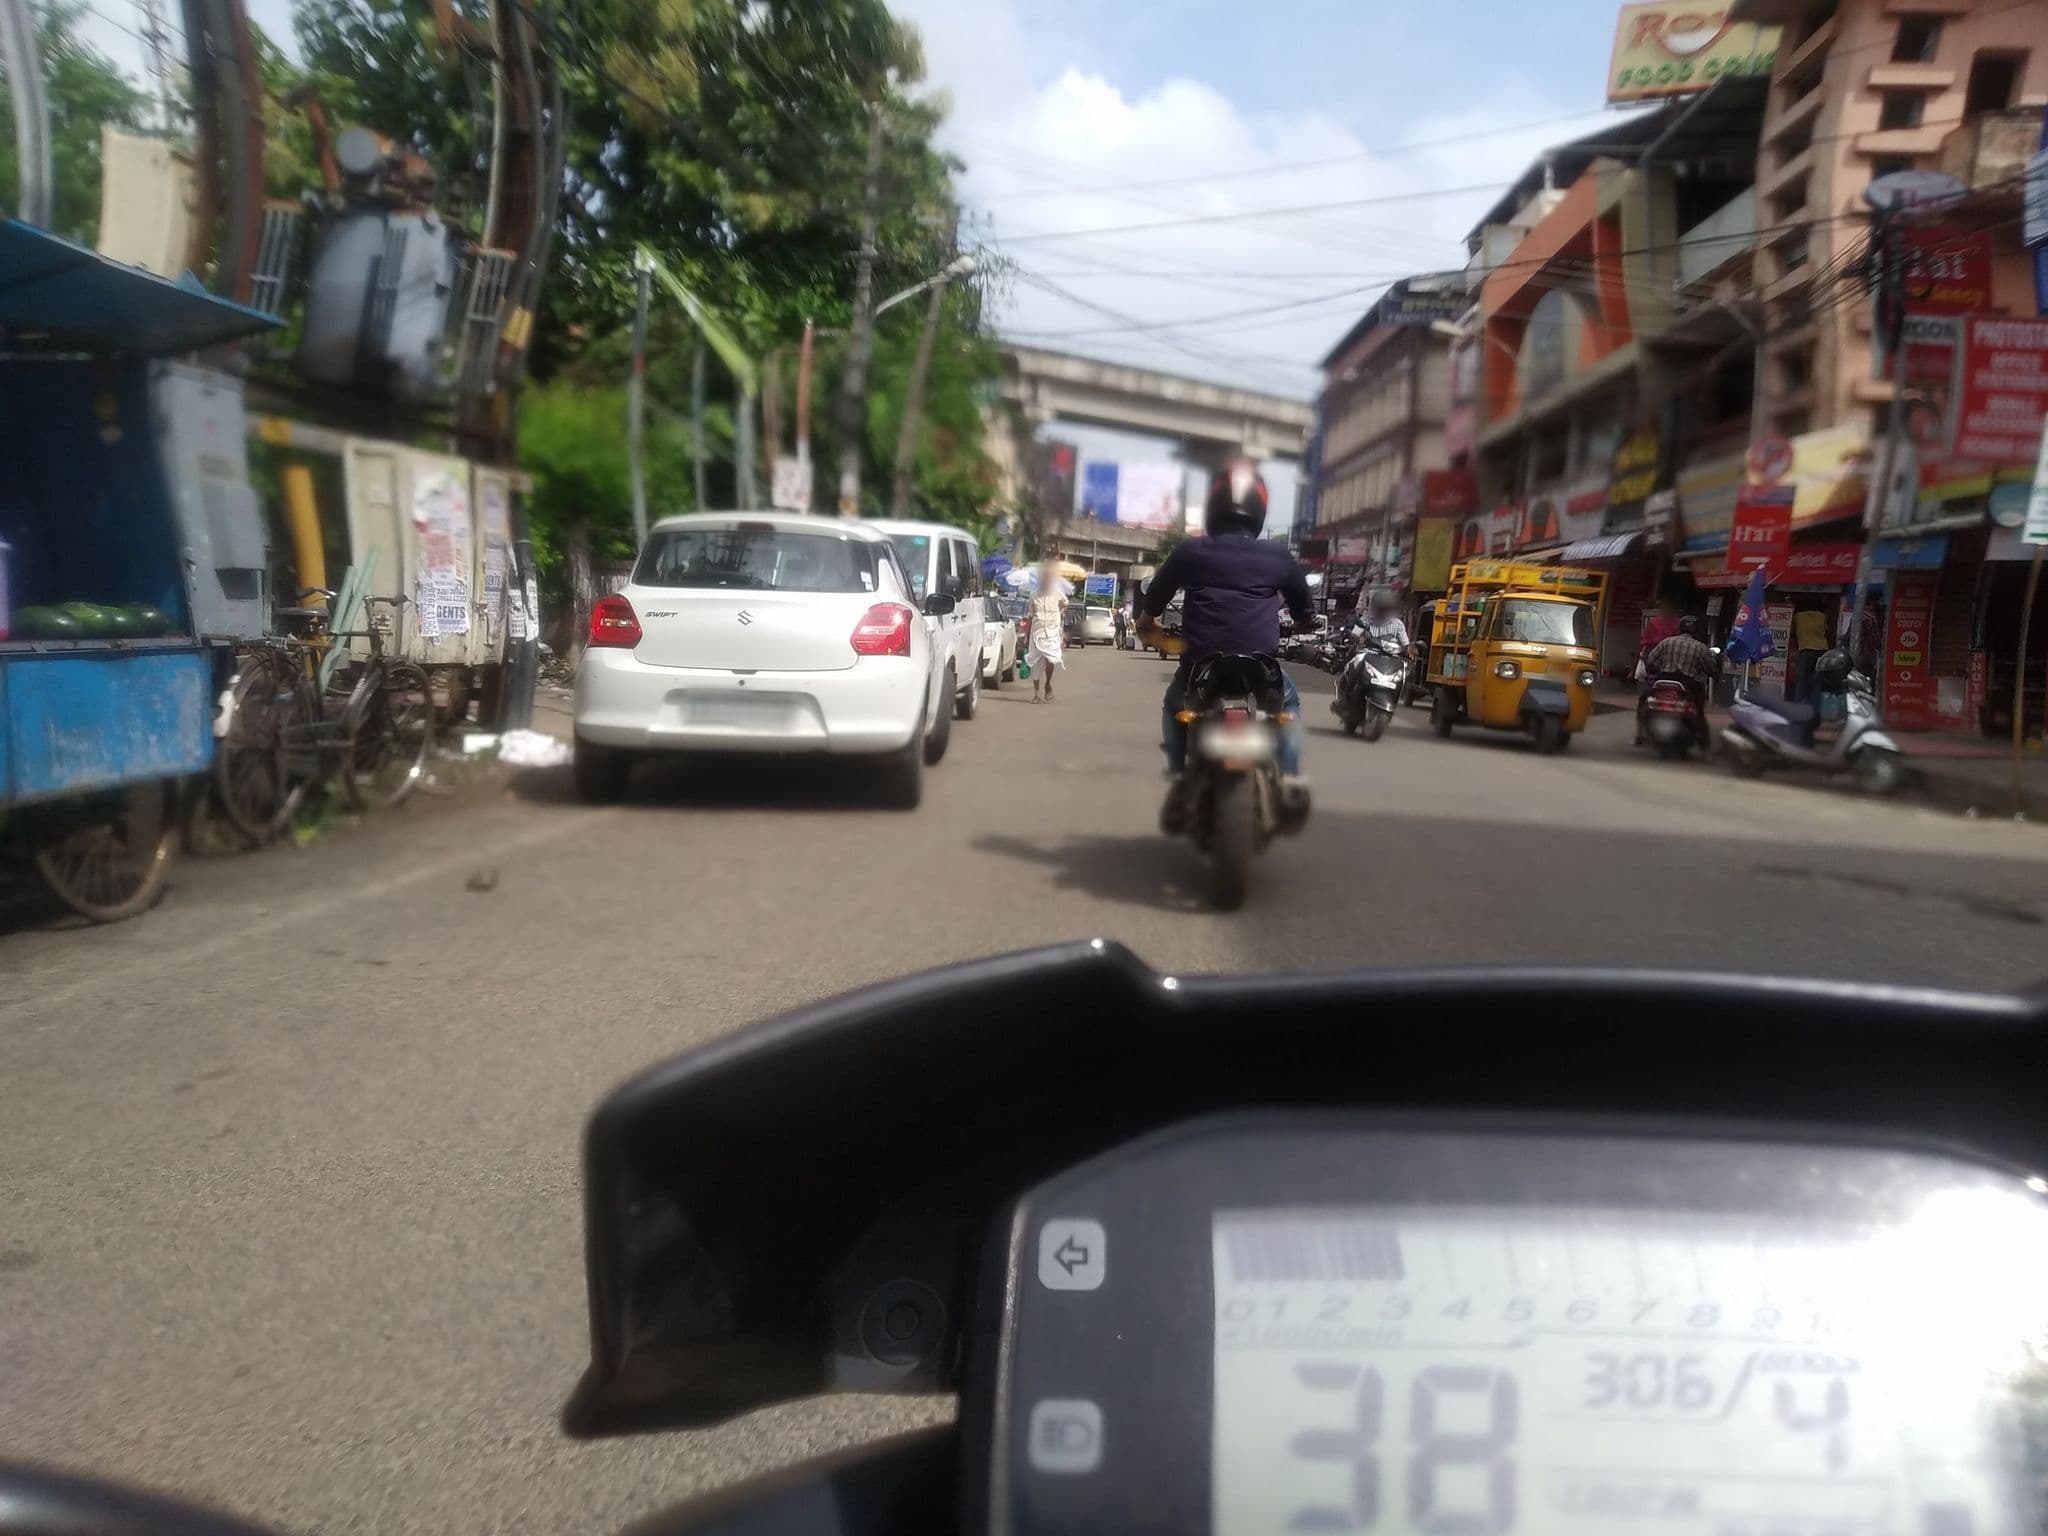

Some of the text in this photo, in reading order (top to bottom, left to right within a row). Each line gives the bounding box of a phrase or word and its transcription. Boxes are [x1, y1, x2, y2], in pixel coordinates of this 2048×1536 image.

[1617, 58, 1695, 89] FOOD
[1786, 553, 1855, 568] airtel 4G
[436, 605, 466, 619] GENTS
[1902, 634, 1917, 643] Jio
[1897, 653, 1917, 663] idea
[1565, 1298, 1600, 1325] 6
[1628, 1299, 1662, 1325] 7
[1583, 1350, 1714, 1411] 306
[1287, 1362, 1520, 1536] 38
